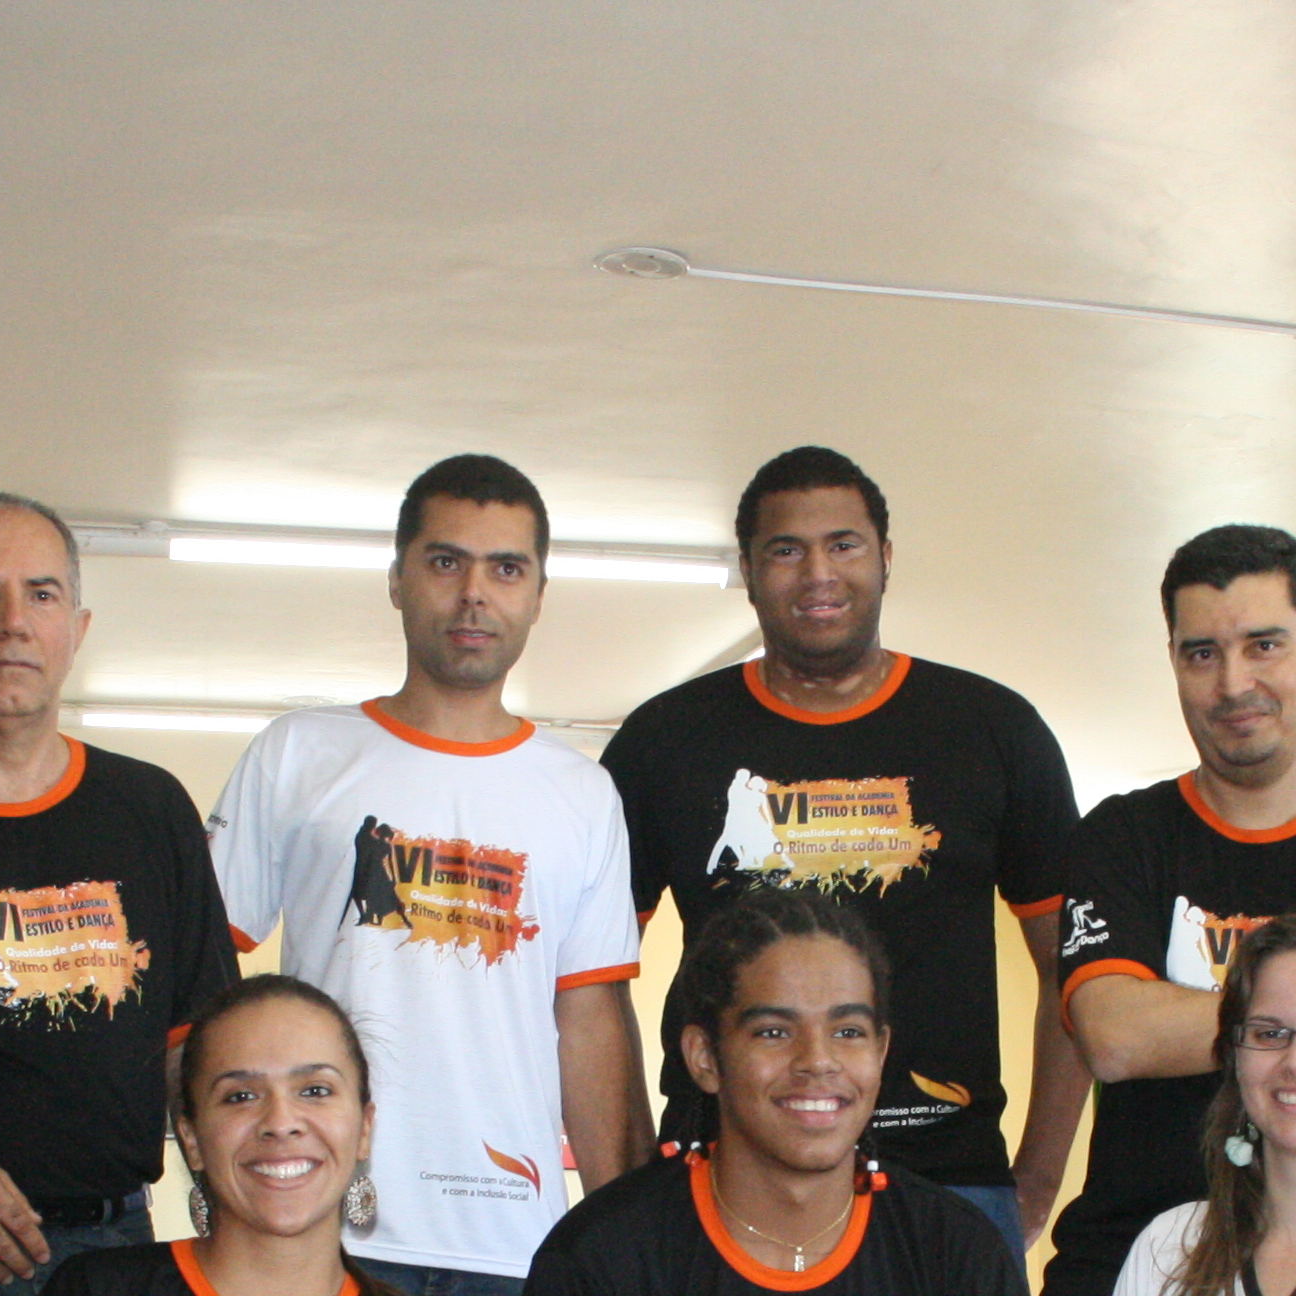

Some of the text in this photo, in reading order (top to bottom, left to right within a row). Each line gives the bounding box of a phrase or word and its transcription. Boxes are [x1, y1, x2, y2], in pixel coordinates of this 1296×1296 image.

[812, 792, 895, 802] FESTIVAL DA ACADEMIA
[767, 792, 808, 825] VI
[812, 804, 898, 818] ESTILO E DANÇA
[787, 829, 847, 838] Qualidade
[850, 827, 864, 836] de
[773, 837, 911, 855] O Ritmo de cada Um
[394, 844, 433, 886] VI
[410, 889, 464, 907] Qualidade
[23, 907, 55, 918] FESTIVAL
[57, 904, 69, 914] DA
[411, 902, 442, 921] Ritmo
[447, 909, 462, 923] de
[467, 914, 491, 930] cada
[25, 913, 115, 937] ESTILO E DANÇA
[5, 946, 67, 958] Qualidade
[70, 942, 86, 952] de
[8, 960, 48, 973] Ritmo
[53, 957, 70, 972] de
[75, 953, 105, 968] cada
[911, 1106, 929, 1114] com
[930, 1105, 935, 1113] a
[880, 1120, 899, 1128] com
[419, 1171, 479, 1183] Compromisso
[508, 1191, 529, 1201] Social
